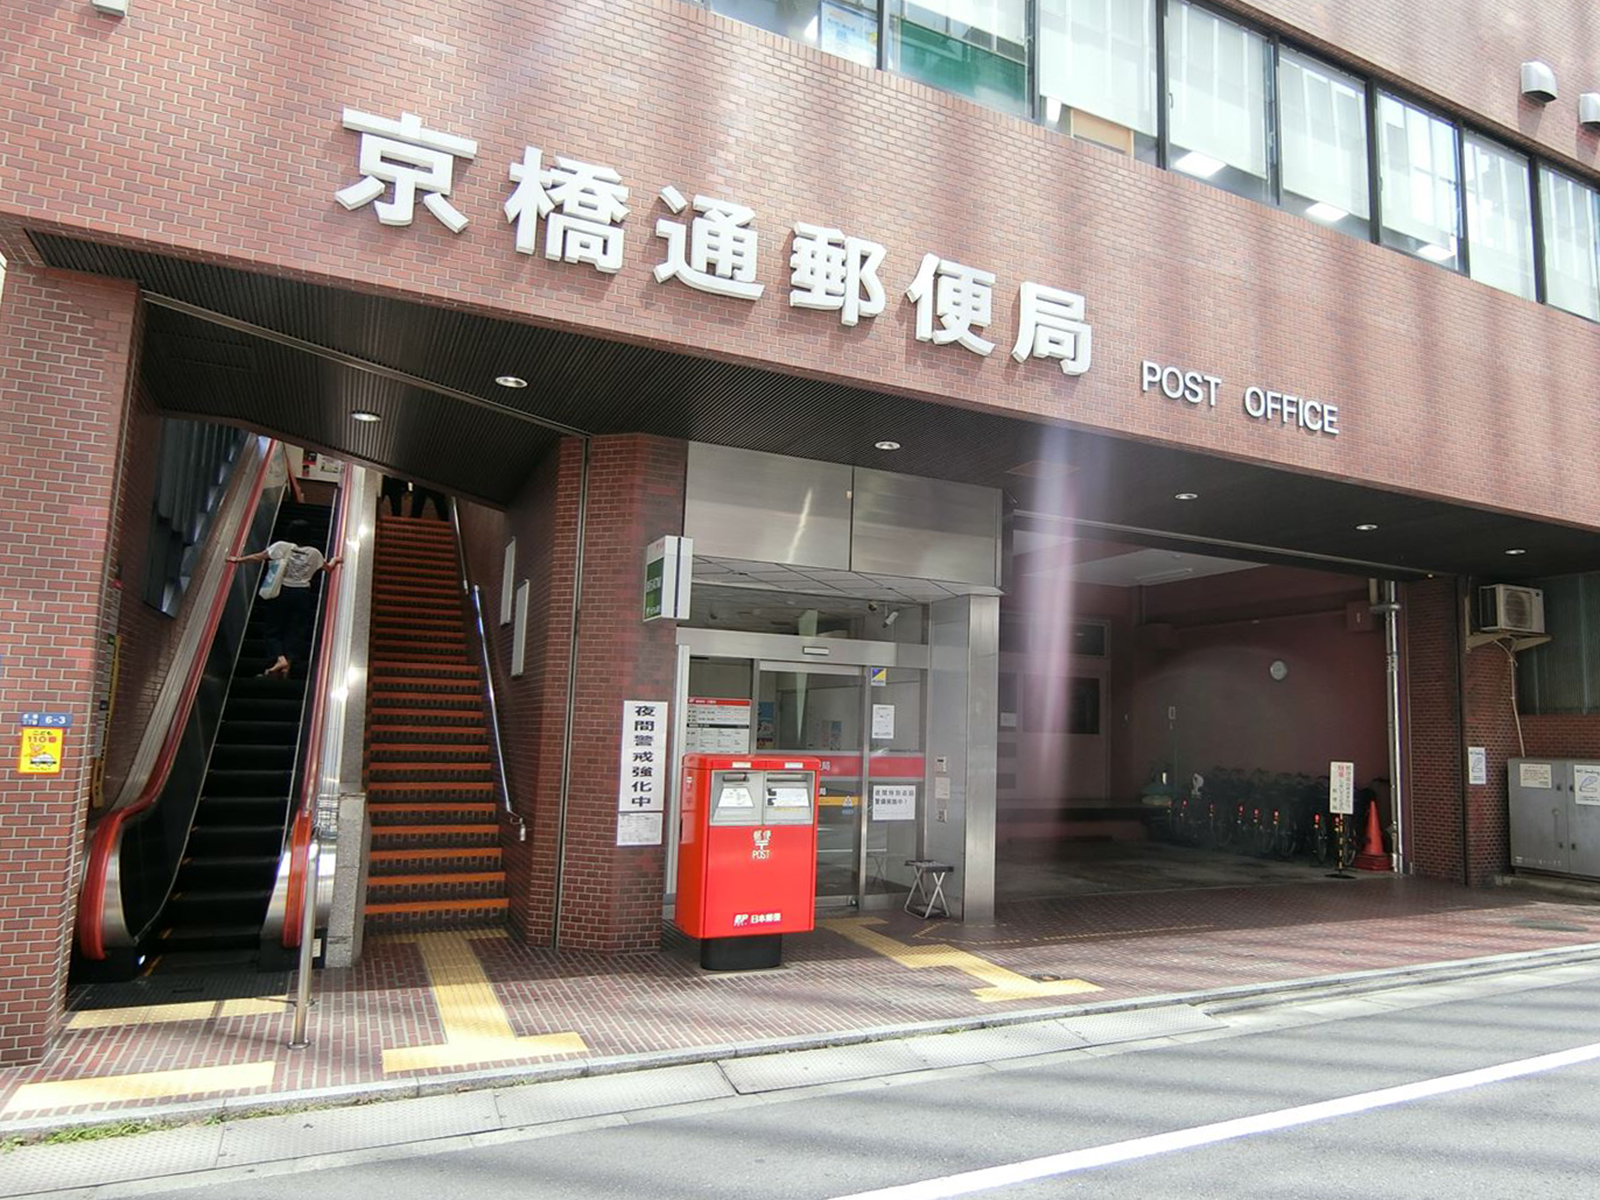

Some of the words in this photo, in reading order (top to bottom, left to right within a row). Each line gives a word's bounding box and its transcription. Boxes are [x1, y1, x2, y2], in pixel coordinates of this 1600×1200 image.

[335, 107, 1092, 376] 京橋通郵便局
[1140, 360, 1222, 407] POST
[1244, 386, 1340, 435] OFFICE
[45, 715, 66, 725] 6-3
[631, 705, 656, 808] 夜間警戒強化中
[752, 849, 770, 860] POST
